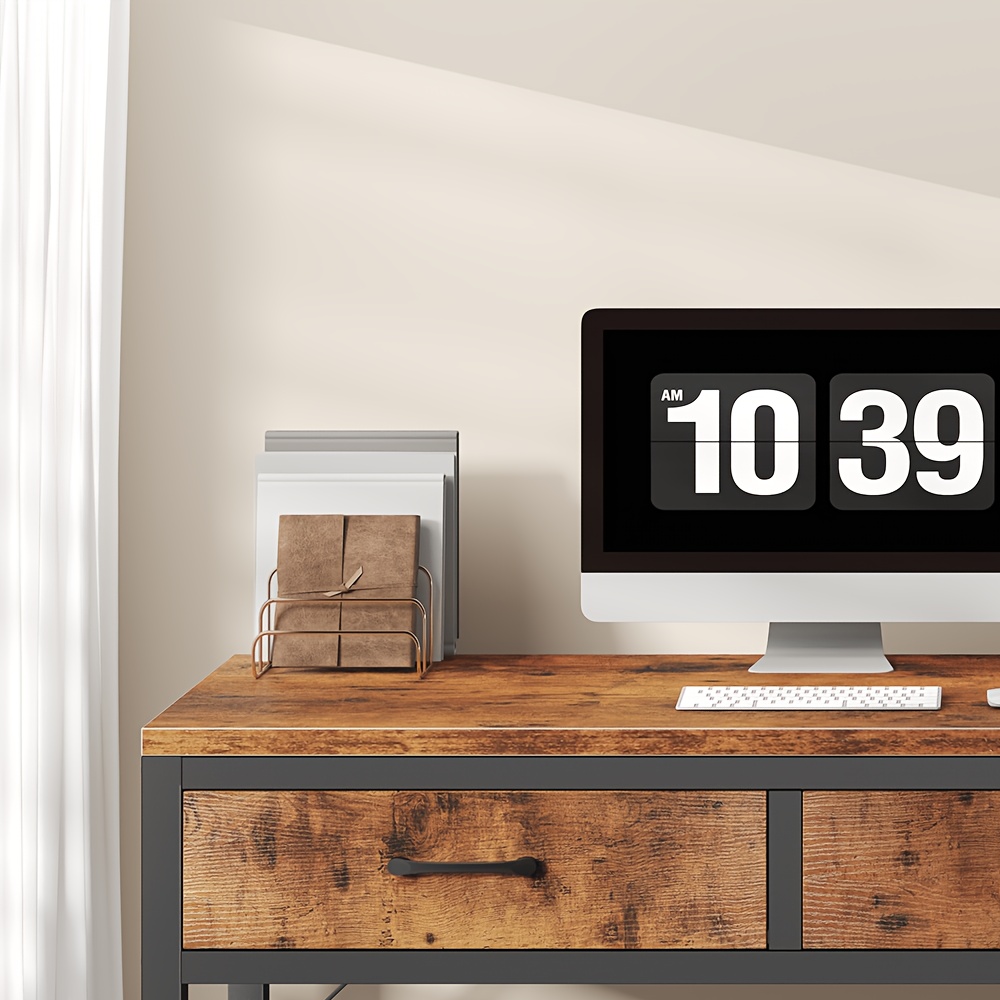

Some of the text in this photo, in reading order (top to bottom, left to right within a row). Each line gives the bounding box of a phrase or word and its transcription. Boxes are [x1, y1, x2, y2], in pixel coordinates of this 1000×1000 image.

[661, 389, 683, 401] AM
[667, 389, 984, 496] 10 39
